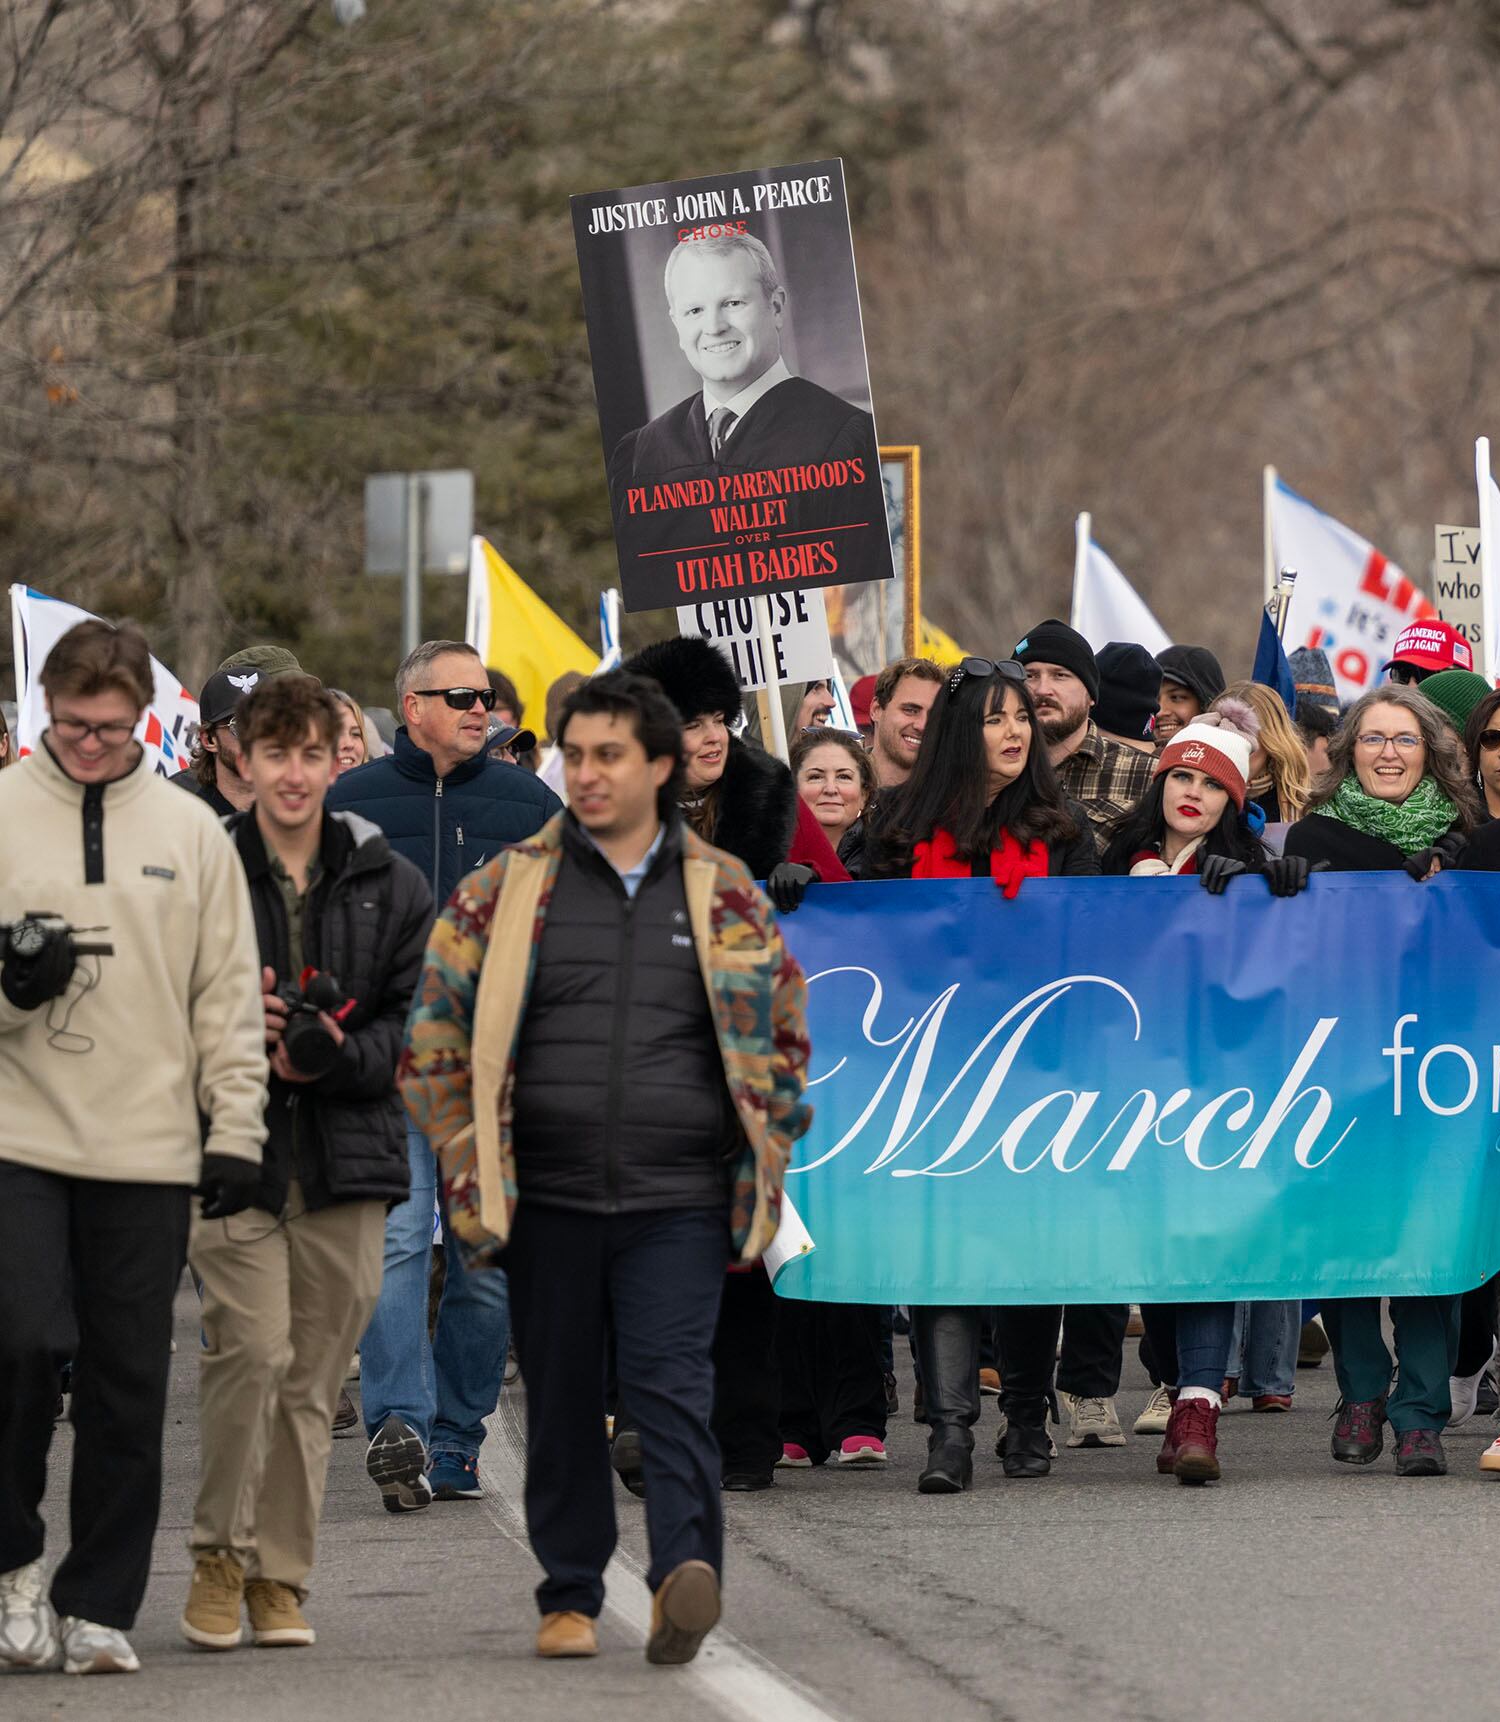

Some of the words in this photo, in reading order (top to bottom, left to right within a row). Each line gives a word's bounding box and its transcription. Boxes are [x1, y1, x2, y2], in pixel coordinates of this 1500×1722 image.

[588, 199, 668, 235] JUSTICE
[672, 190, 726, 223] JOHN
[732, 188, 750, 215] A.
[752, 175, 832, 212] PEARCE
[677, 220, 748, 243] CHOSE
[627, 479, 715, 515] PLANNED
[718, 457, 866, 502] PARENTHOOD'S
[710, 499, 787, 534] WALLET
[735, 532, 771, 545] OVER
[1440, 530, 1481, 564] I'v
[676, 552, 744, 593] UTAH
[747, 540, 839, 585] BABIES
[695, 591, 809, 639] CHOSE
[1410, 628, 1447, 642] AMERICA
[1413, 639, 1441, 653] AGAIN
[785, 966, 1358, 1178] March
